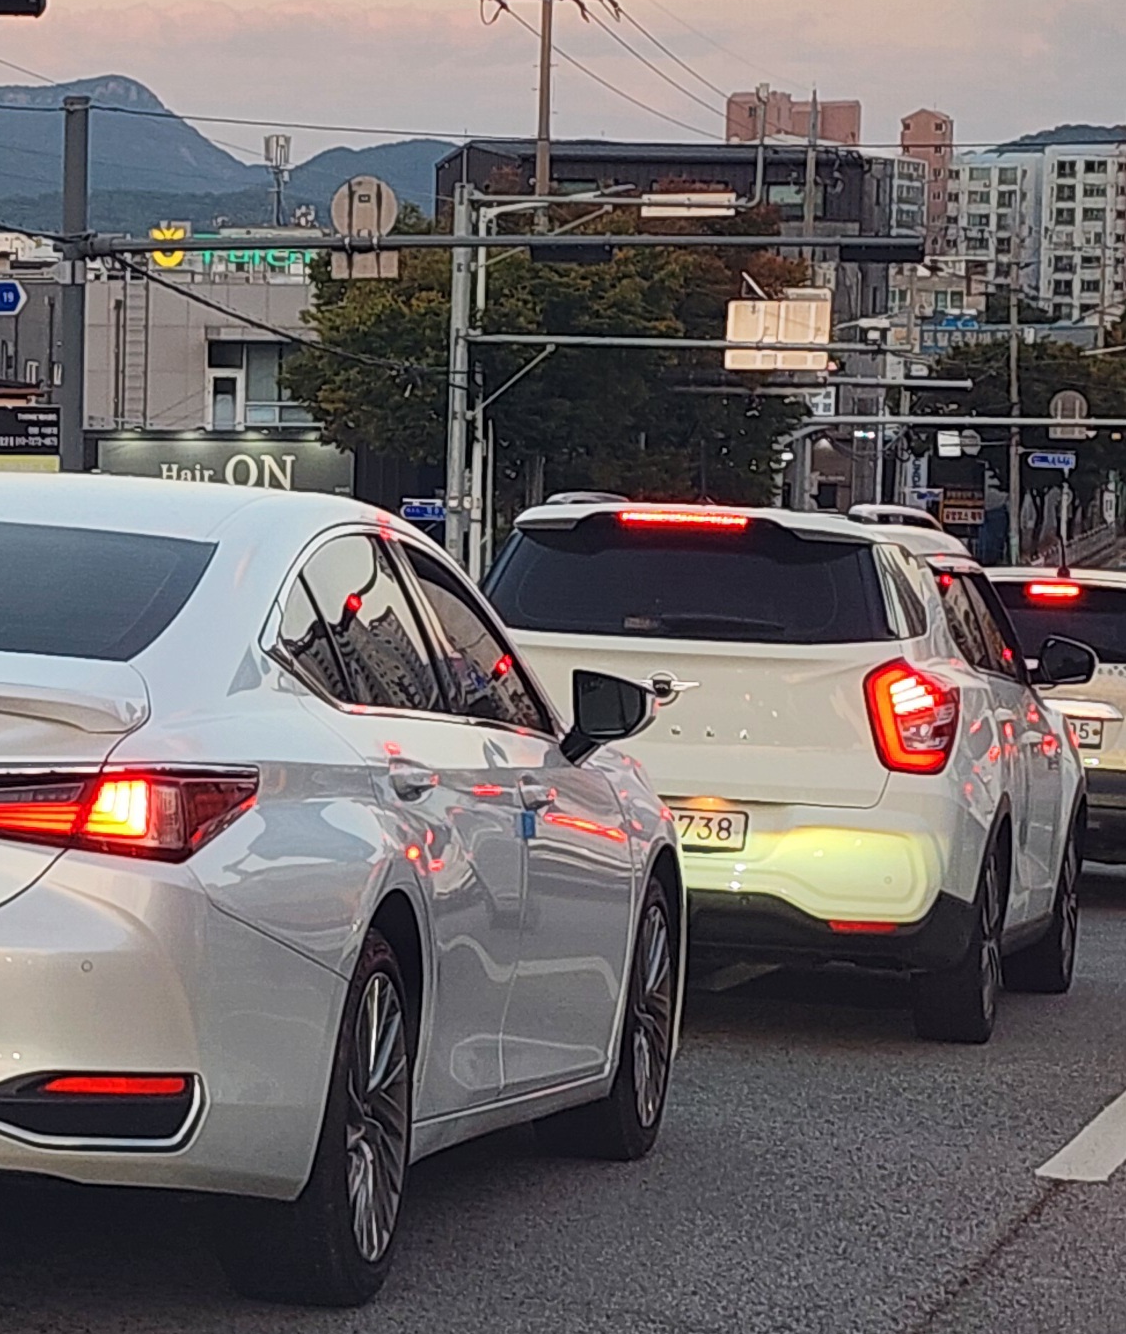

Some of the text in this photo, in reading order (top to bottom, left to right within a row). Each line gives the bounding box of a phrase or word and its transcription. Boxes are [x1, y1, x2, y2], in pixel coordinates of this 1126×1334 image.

[160, 453, 296, 491] Hair ON
[672, 814, 732, 841] 738
